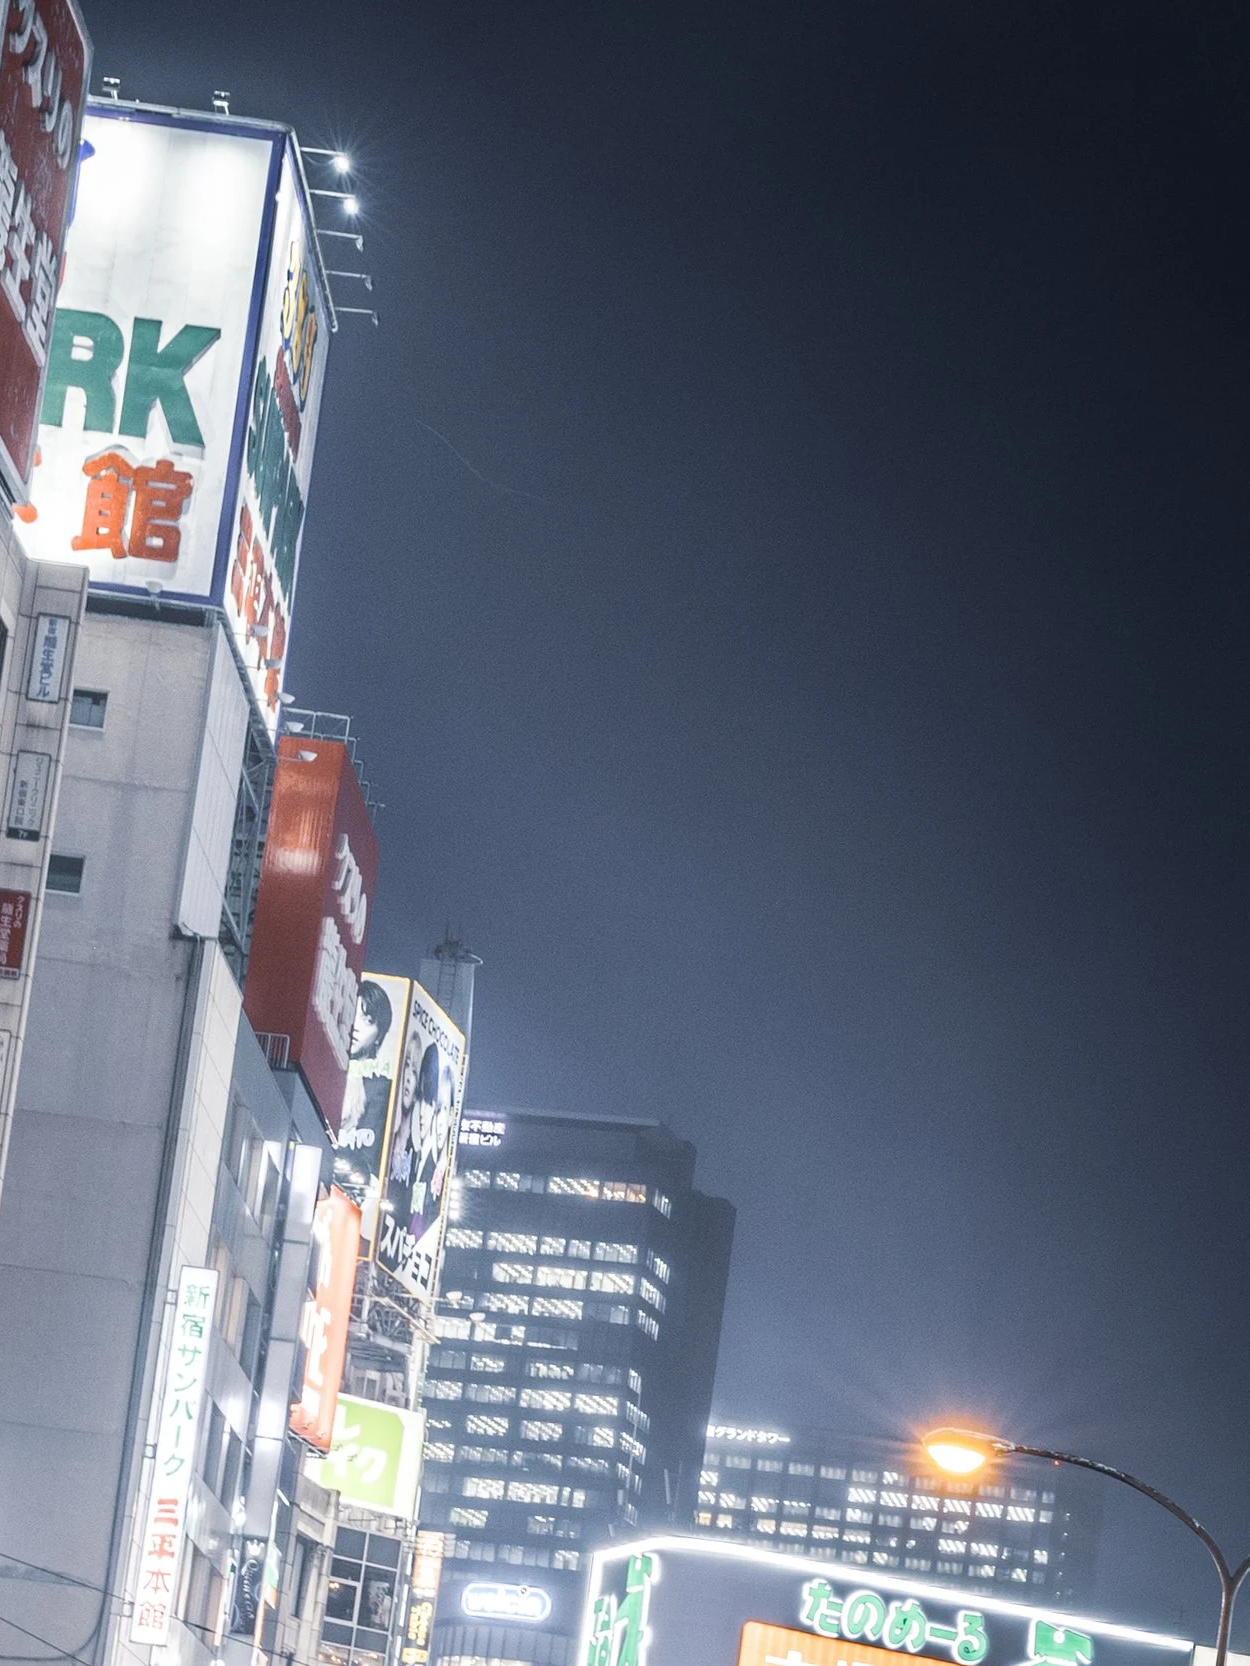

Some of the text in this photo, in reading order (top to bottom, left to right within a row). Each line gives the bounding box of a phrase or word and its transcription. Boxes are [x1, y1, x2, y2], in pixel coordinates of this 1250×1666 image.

[137, 1283, 211, 1631] 新宿サンパーク 三平本館
[800, 1578, 990, 1665] たのめーる
